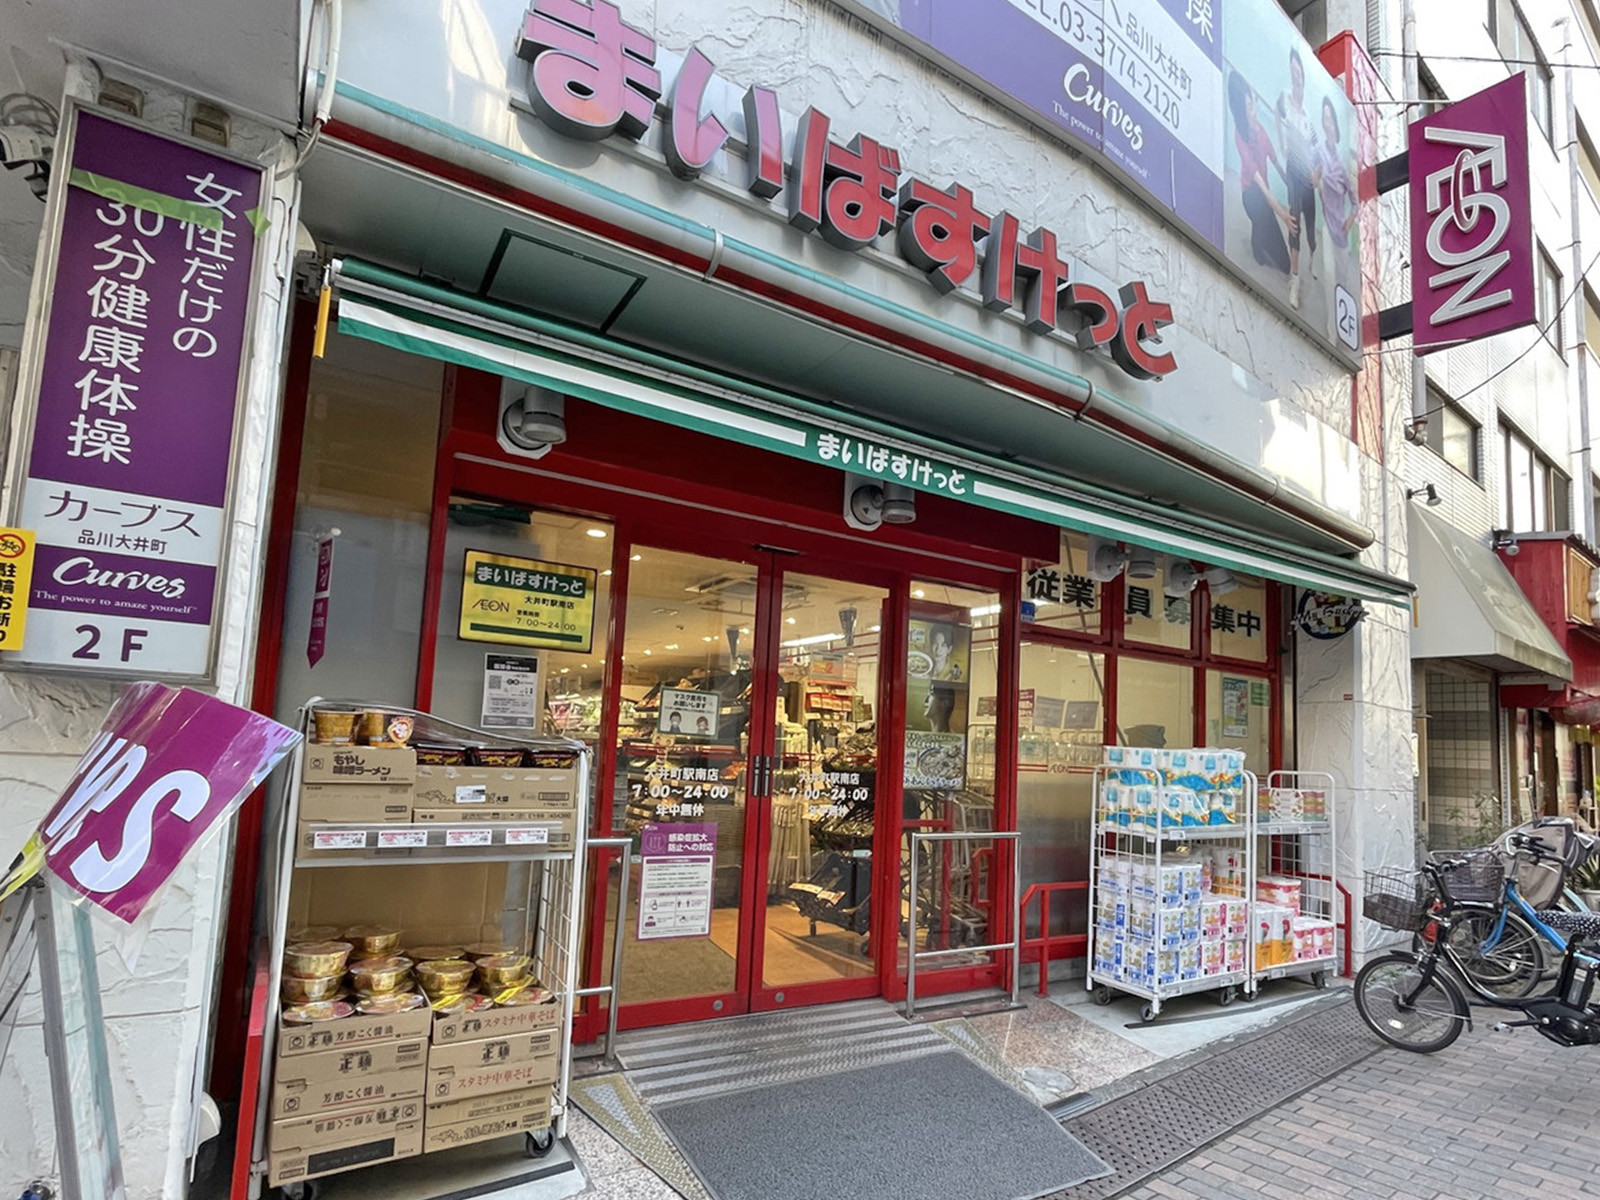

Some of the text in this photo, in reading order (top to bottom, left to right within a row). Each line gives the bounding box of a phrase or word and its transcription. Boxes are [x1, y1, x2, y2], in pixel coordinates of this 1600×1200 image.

[1025, 0, 1181, 129] L.03-3774-2120
[1126, 12, 1193, 100] 品川大井町
[1063, 63, 1143, 151] Curves
[515, 0, 1178, 381] まいばすけっと
[172, 172, 243, 358] 女性だけの
[66, 188, 165, 465] 30分健康体操
[1337, 298, 1356, 333] 2F
[817, 433, 966, 495] まいばすけっと
[44, 490, 201, 538] カーブス
[78, 530, 168, 555] 品川大井町
[52, 556, 186, 599] Curves
[477, 566, 583, 595] まいばすけっと
[34, 589, 192, 615] The power to amaze yourself
[644, 766, 720, 781] 大井町駅南店
[656, 803, 705, 817] 年中無休
[458, 1066, 534, 1089] スタミナ中華そば
